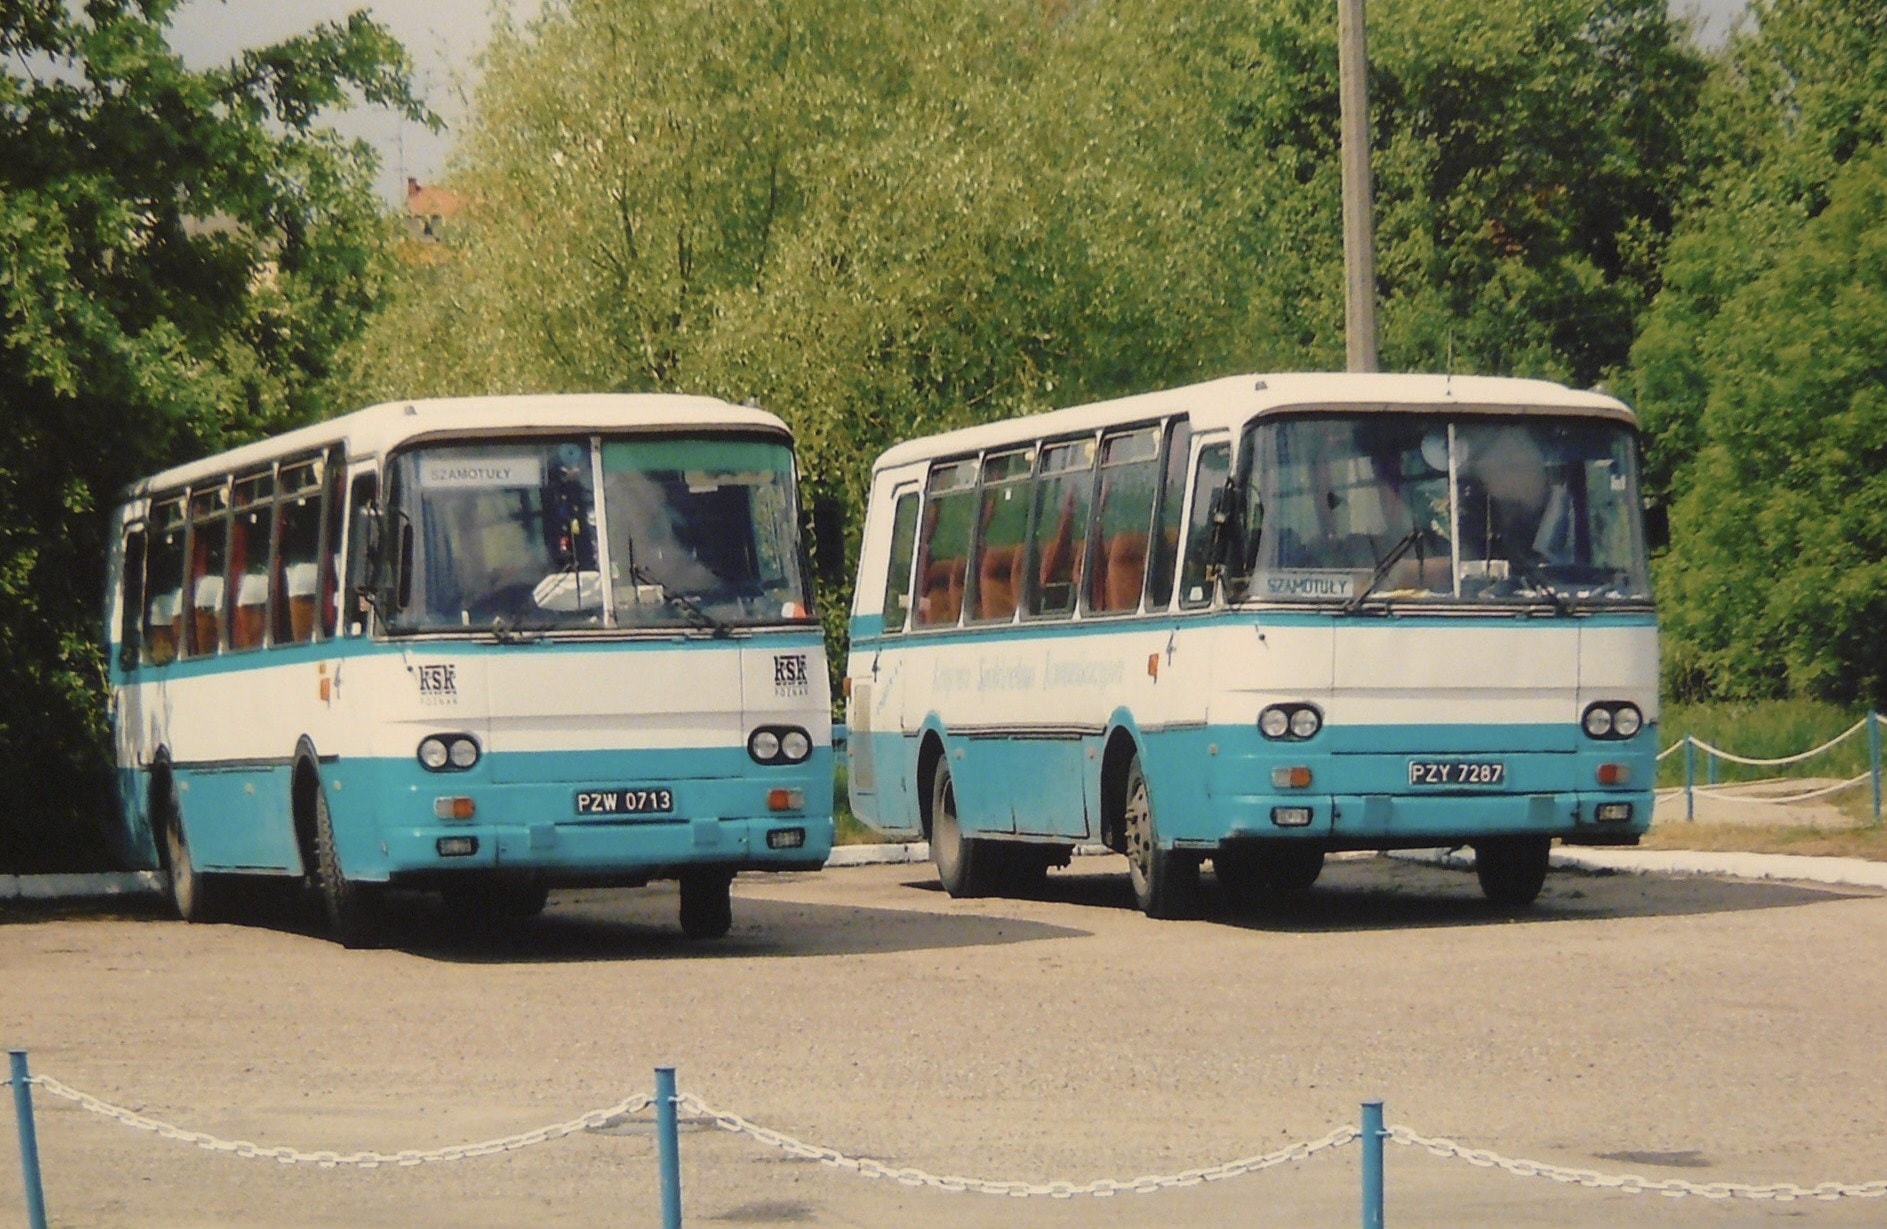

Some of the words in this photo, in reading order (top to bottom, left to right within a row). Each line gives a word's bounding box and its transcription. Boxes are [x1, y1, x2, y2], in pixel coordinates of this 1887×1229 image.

[1412, 764, 1450, 782] PZY
[1458, 764, 1502, 782] 7287
[578, 793, 617, 811] PZW
[626, 791, 670, 810] 0713
